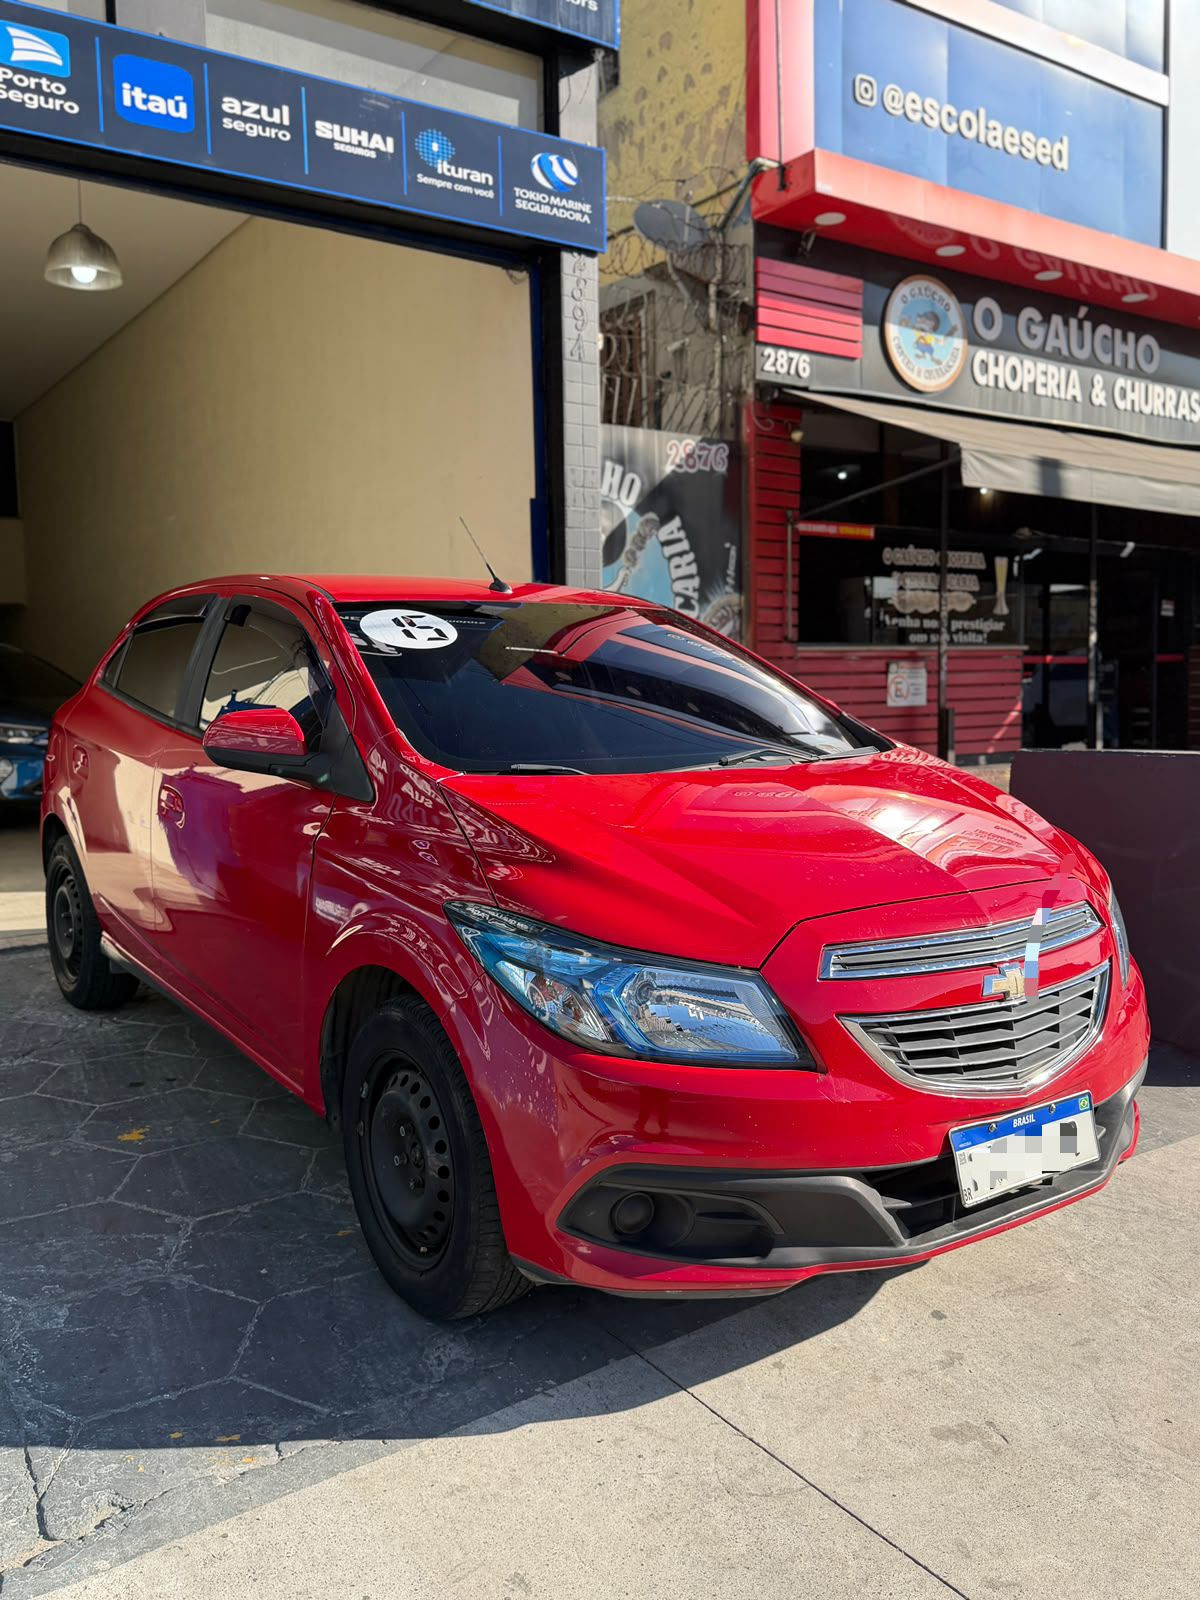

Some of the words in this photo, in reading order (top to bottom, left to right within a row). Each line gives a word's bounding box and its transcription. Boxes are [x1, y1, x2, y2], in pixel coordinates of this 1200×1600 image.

[0, 67, 67, 95] Porto
[0, 83, 80, 115] Seguro
[121, 82, 188, 119] itaú
[221, 96, 291, 126] azul
[222, 117, 292, 141] seguro
[315, 119, 394, 154] SUHAI
[883, 83, 1069, 172] @escolaesed
[416, 173, 453, 189] Sempre
[453, 183, 474, 194] com
[473, 187, 495, 199] você
[436, 158, 494, 186] ituran
[513, 186, 549, 204] TOKIO
[549, 195, 593, 214] MARINE
[514, 198, 592, 224] SEGURADORA
[973, 297, 1003, 342] O
[1017, 305, 1161, 374] GAÚCHO
[762, 347, 811, 379] 2876
[972, 350, 1083, 403] CHOPERIA
[1091, 373, 1107, 408] &
[1112, 377, 1200, 423] CHURRAS
[665, 440, 729, 474] 2876
[1012, 1113, 1036, 1128] BRASIL
